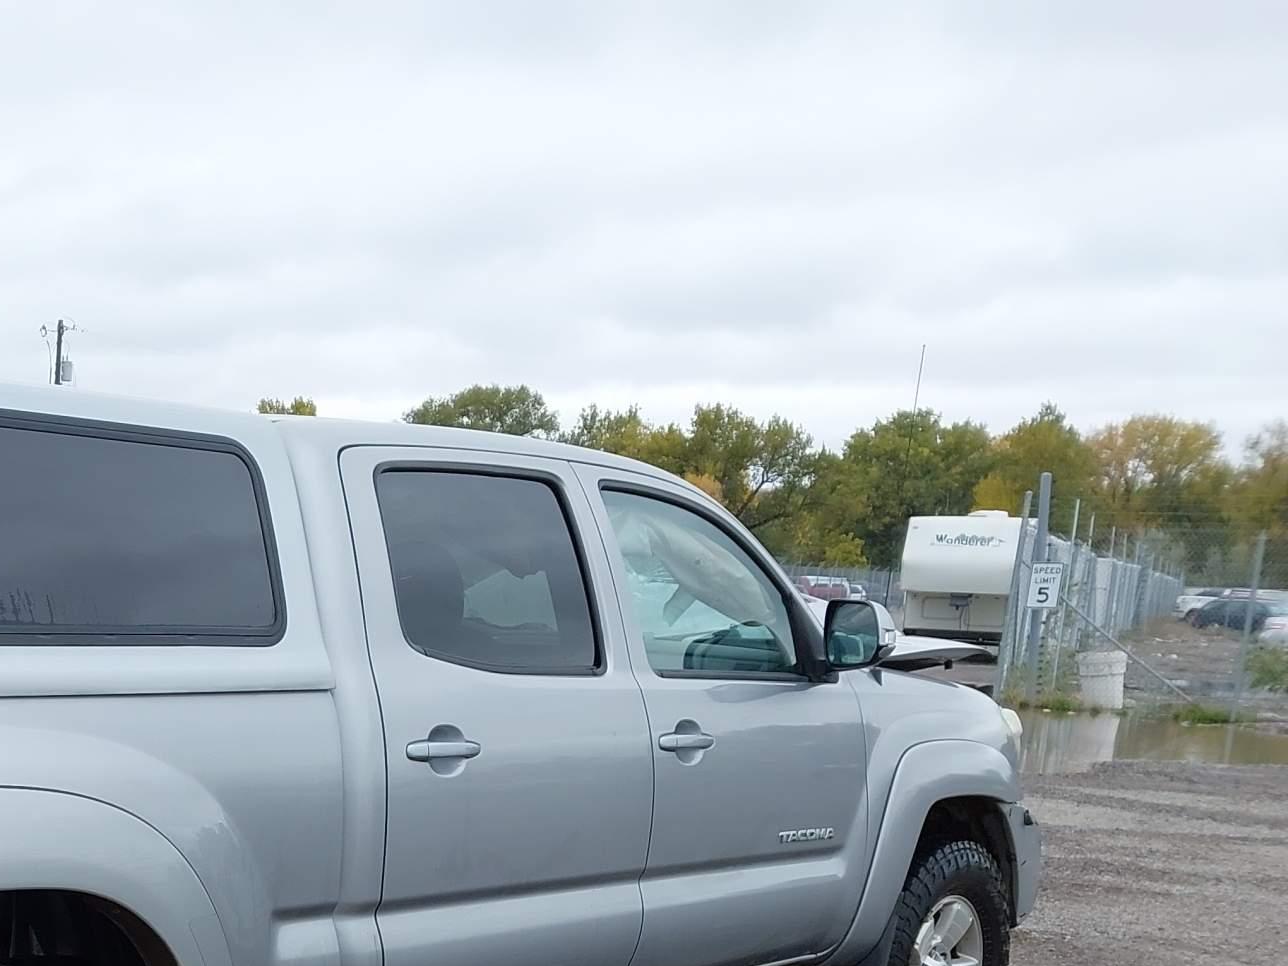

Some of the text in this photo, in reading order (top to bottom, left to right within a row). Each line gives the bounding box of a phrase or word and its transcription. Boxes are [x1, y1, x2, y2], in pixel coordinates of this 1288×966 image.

[935, 533, 995, 546] Wanderer
[1033, 566, 1061, 575] SPEED
[1034, 576, 1057, 584] LIMIT
[1036, 586, 1050, 604] 5
[778, 827, 835, 843] TACOMA
